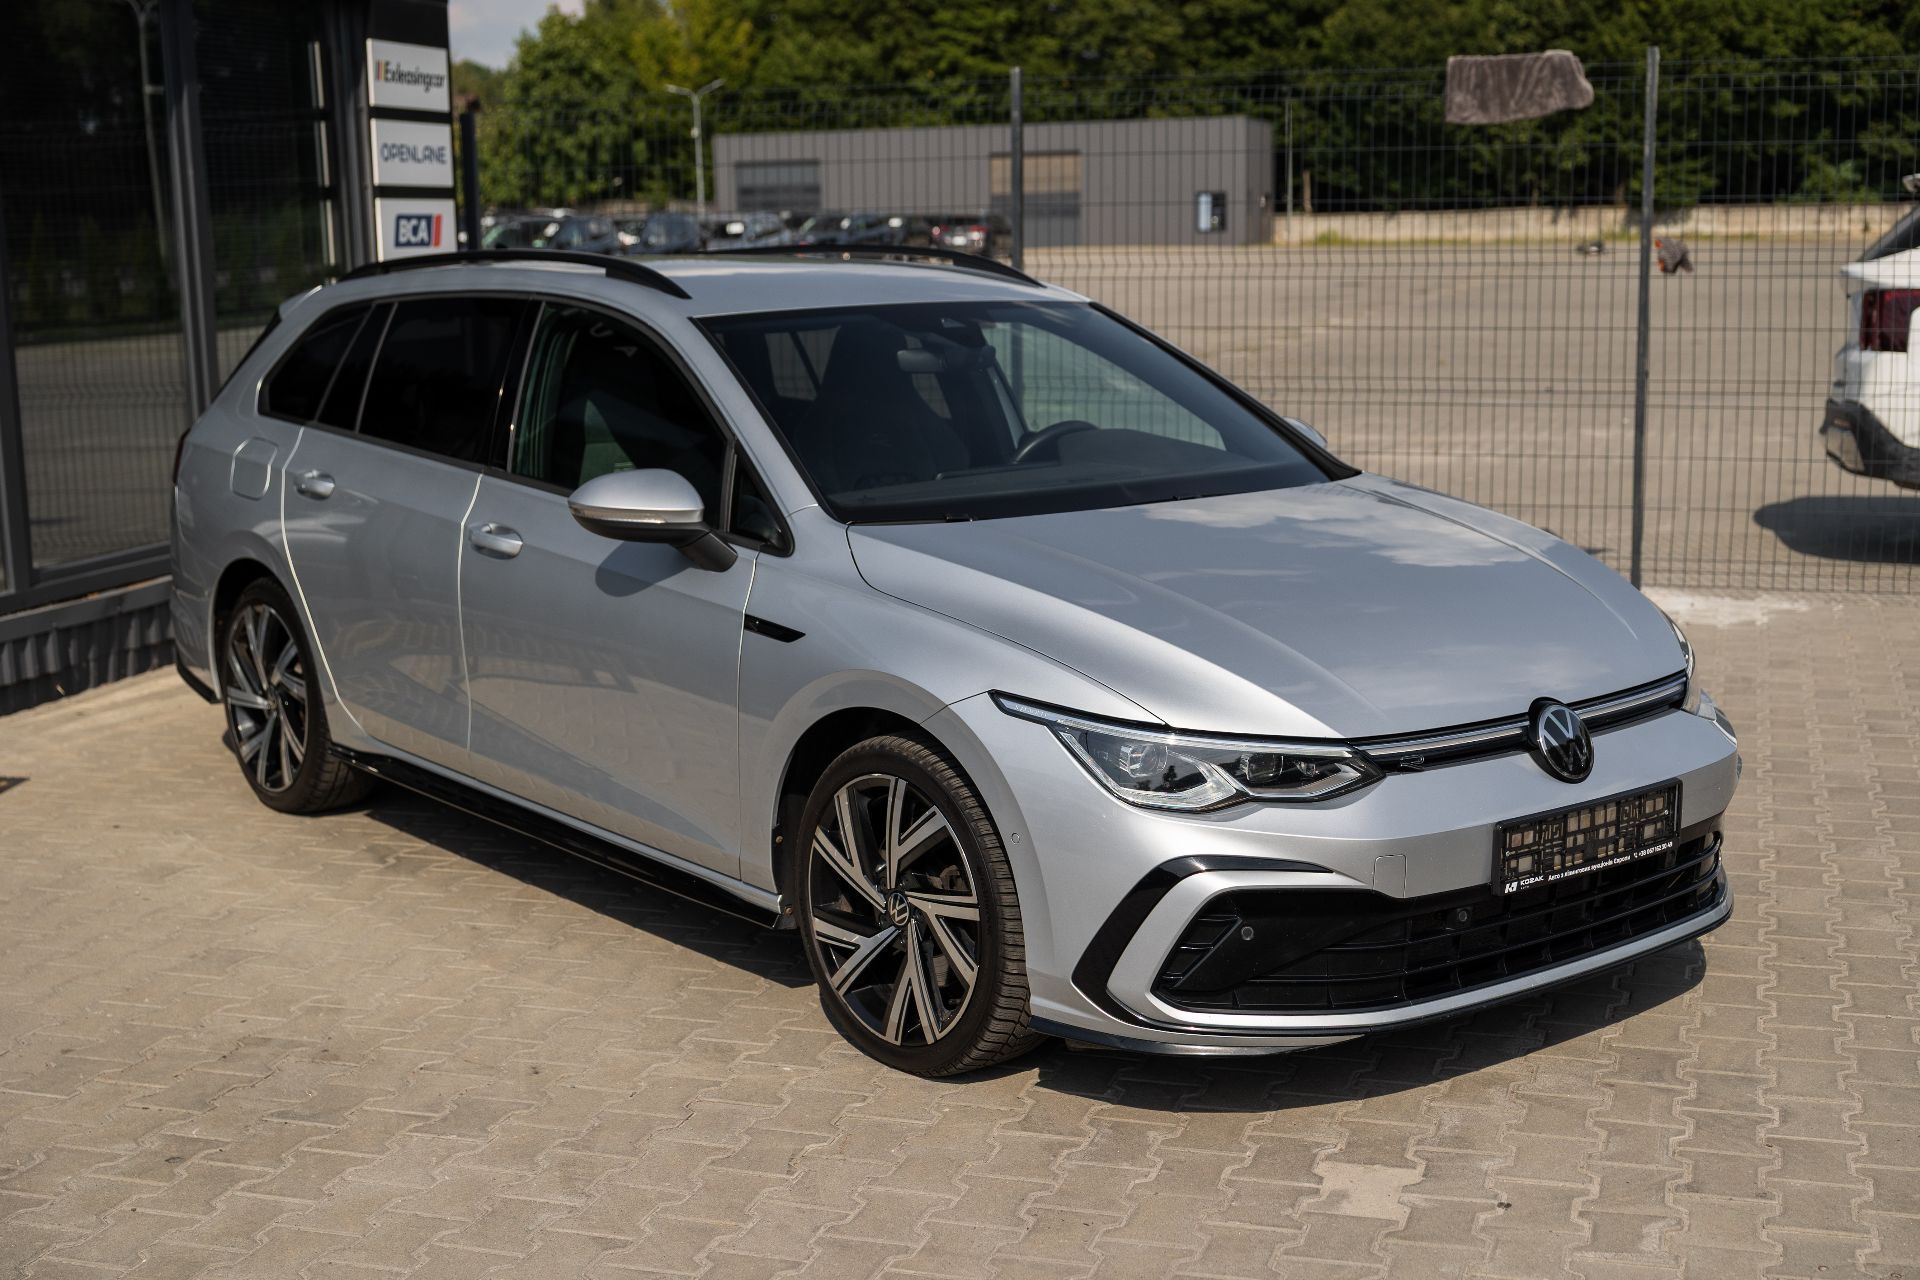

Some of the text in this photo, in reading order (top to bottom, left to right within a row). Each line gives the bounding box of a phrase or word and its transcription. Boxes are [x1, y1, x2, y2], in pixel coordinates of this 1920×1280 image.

[384, 60, 446, 93] Exleasingcar
[380, 142, 447, 165] OPENLANE
[398, 218, 430, 245] BCA
